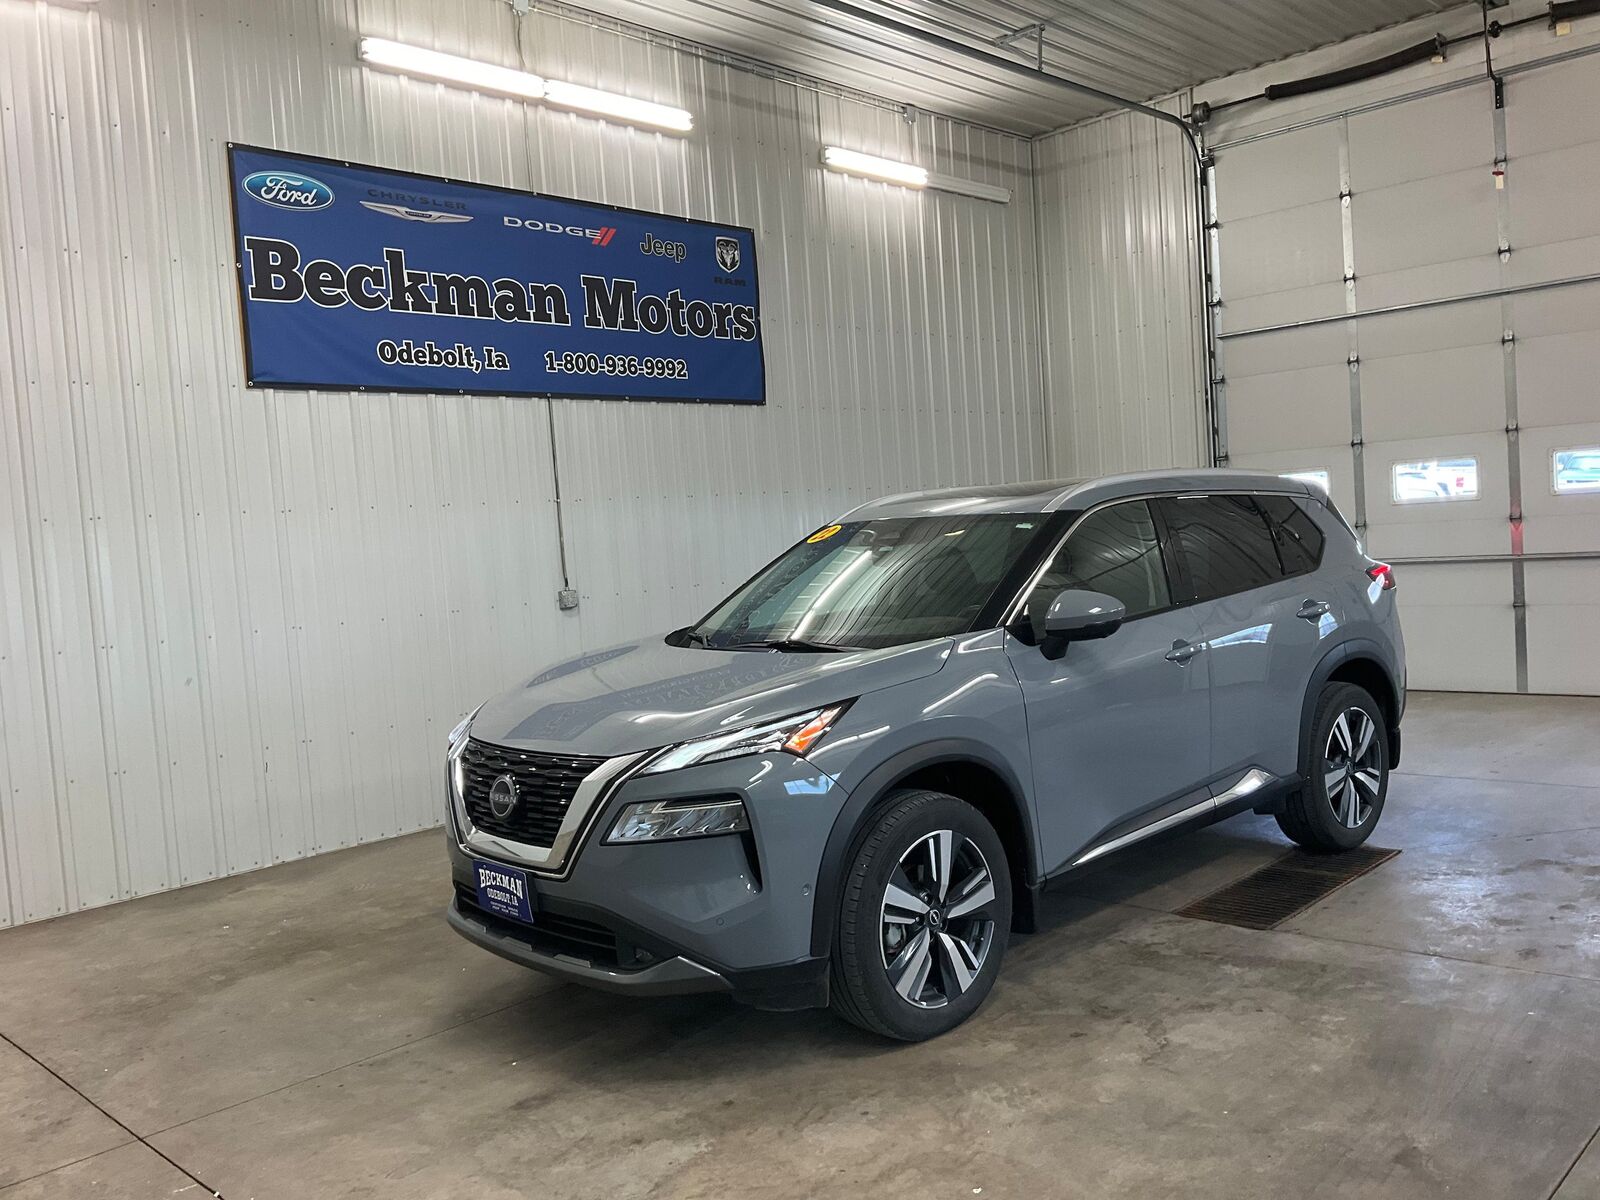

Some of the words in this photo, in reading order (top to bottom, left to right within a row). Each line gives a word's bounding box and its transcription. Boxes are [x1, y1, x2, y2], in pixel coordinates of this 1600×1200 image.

[260, 174, 317, 206] Ford
[367, 188, 467, 210] CHRYSLER
[503, 216, 602, 239] DODGE
[639, 233, 687, 263] Jeep
[244, 235, 571, 326] Beckman
[580, 274, 757, 341] Motors
[713, 276, 747, 287] RAM
[543, 351, 689, 380] 1-800-936-9992
[478, 868, 523, 899] BECKMAN
